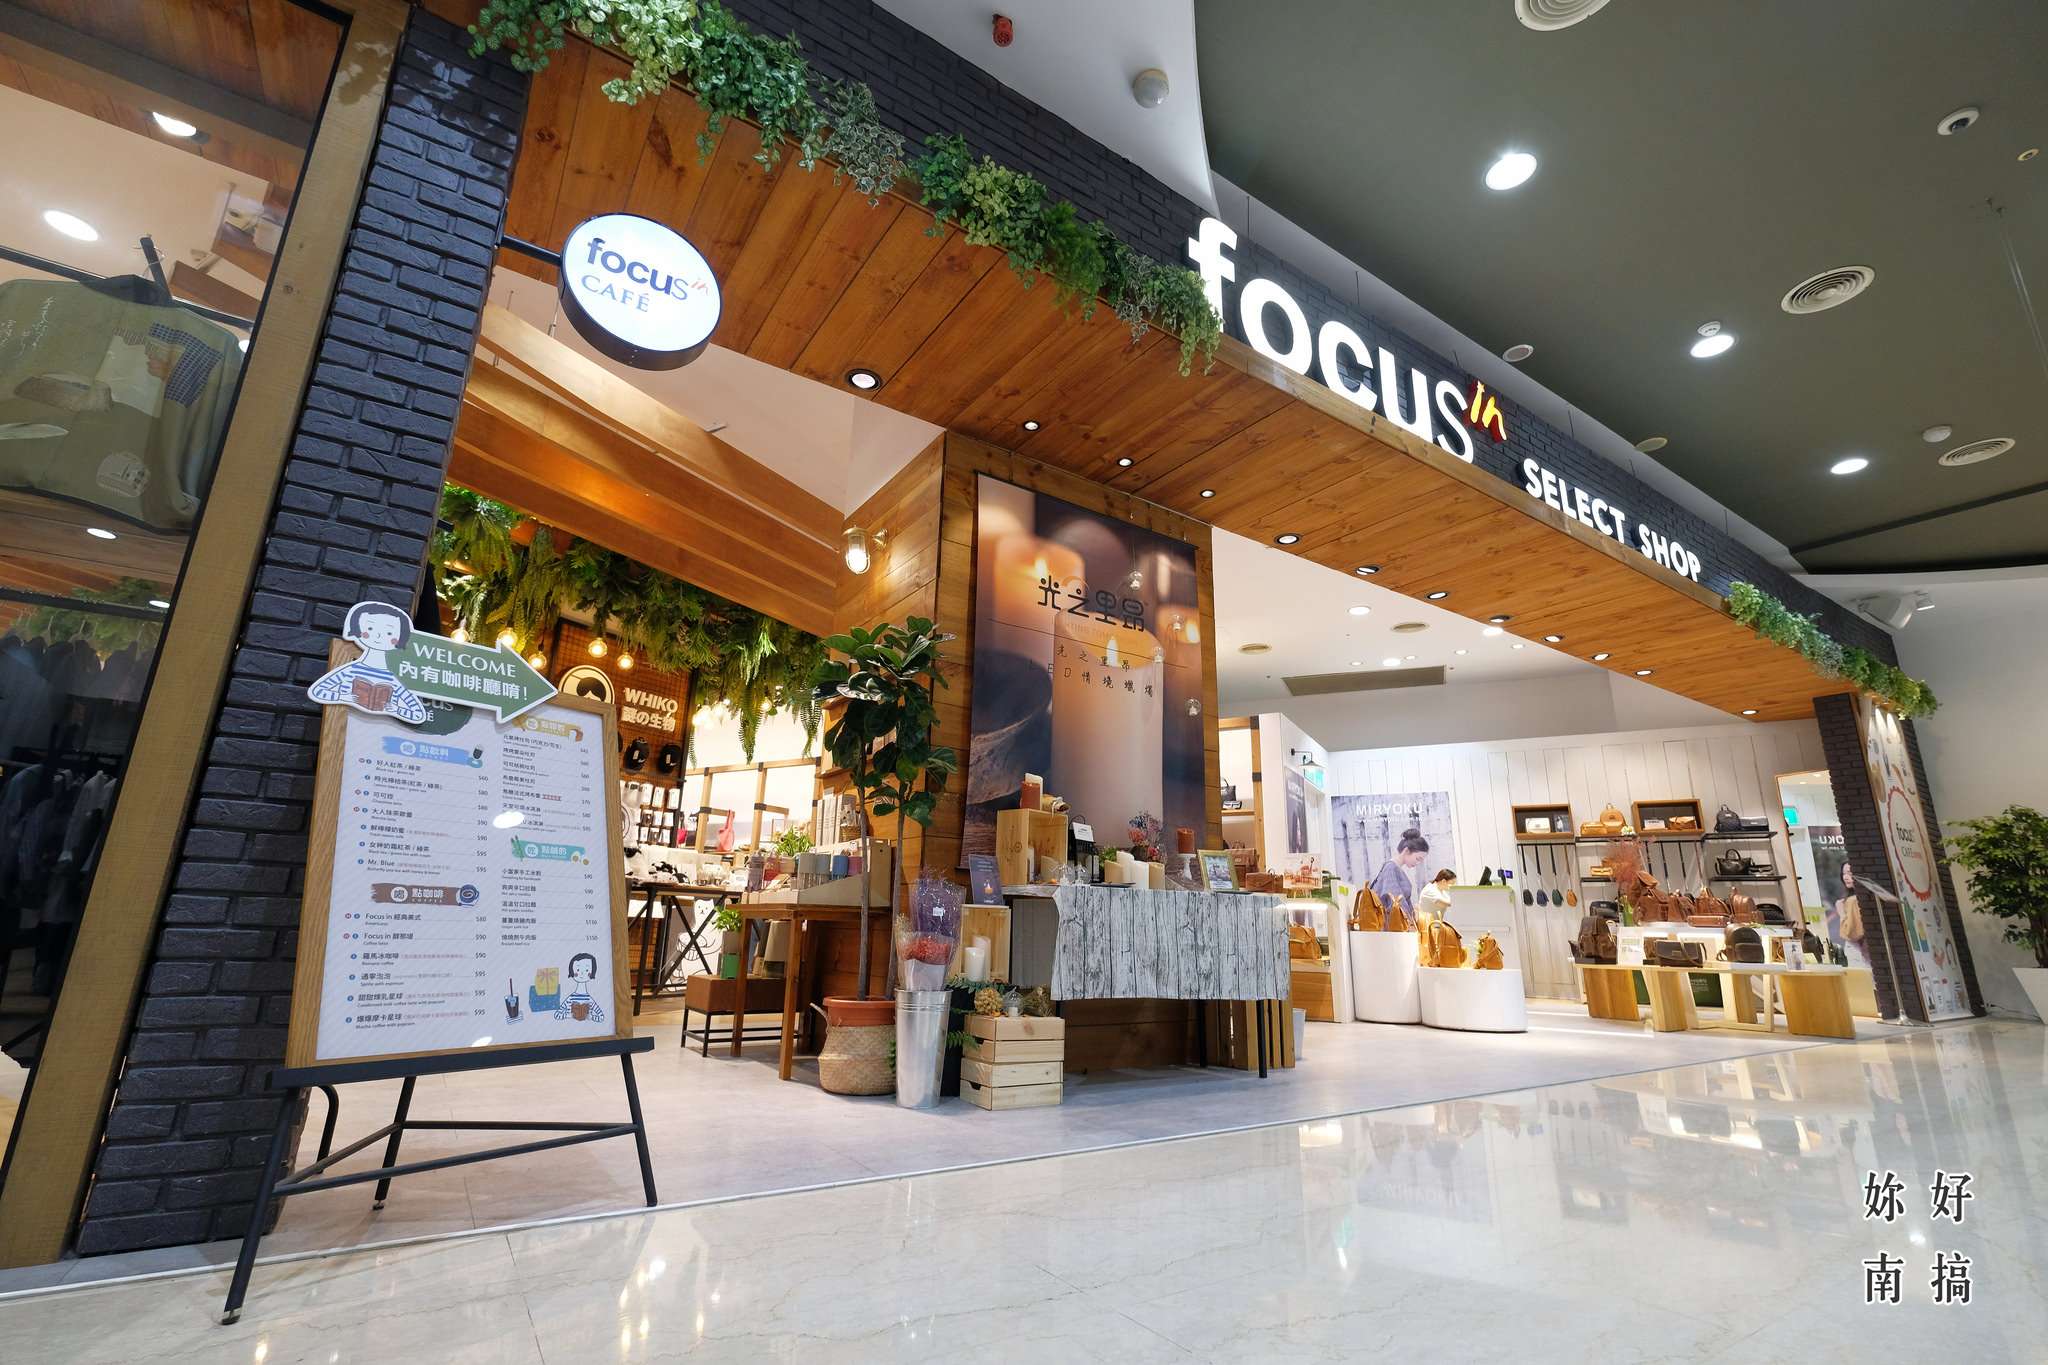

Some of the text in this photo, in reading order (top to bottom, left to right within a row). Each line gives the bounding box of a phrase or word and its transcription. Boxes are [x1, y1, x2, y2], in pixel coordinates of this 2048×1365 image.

[587, 237, 689, 301] focus
[581, 274, 650, 313] CAFÉ
[1188, 217, 1508, 464] focus in
[1523, 458, 1702, 583] SELECT SHOP
[412, 642, 516, 678] WELCOME
[624, 687, 678, 713] WHIKO
[1356, 802, 1423, 817] MIRYOKU
